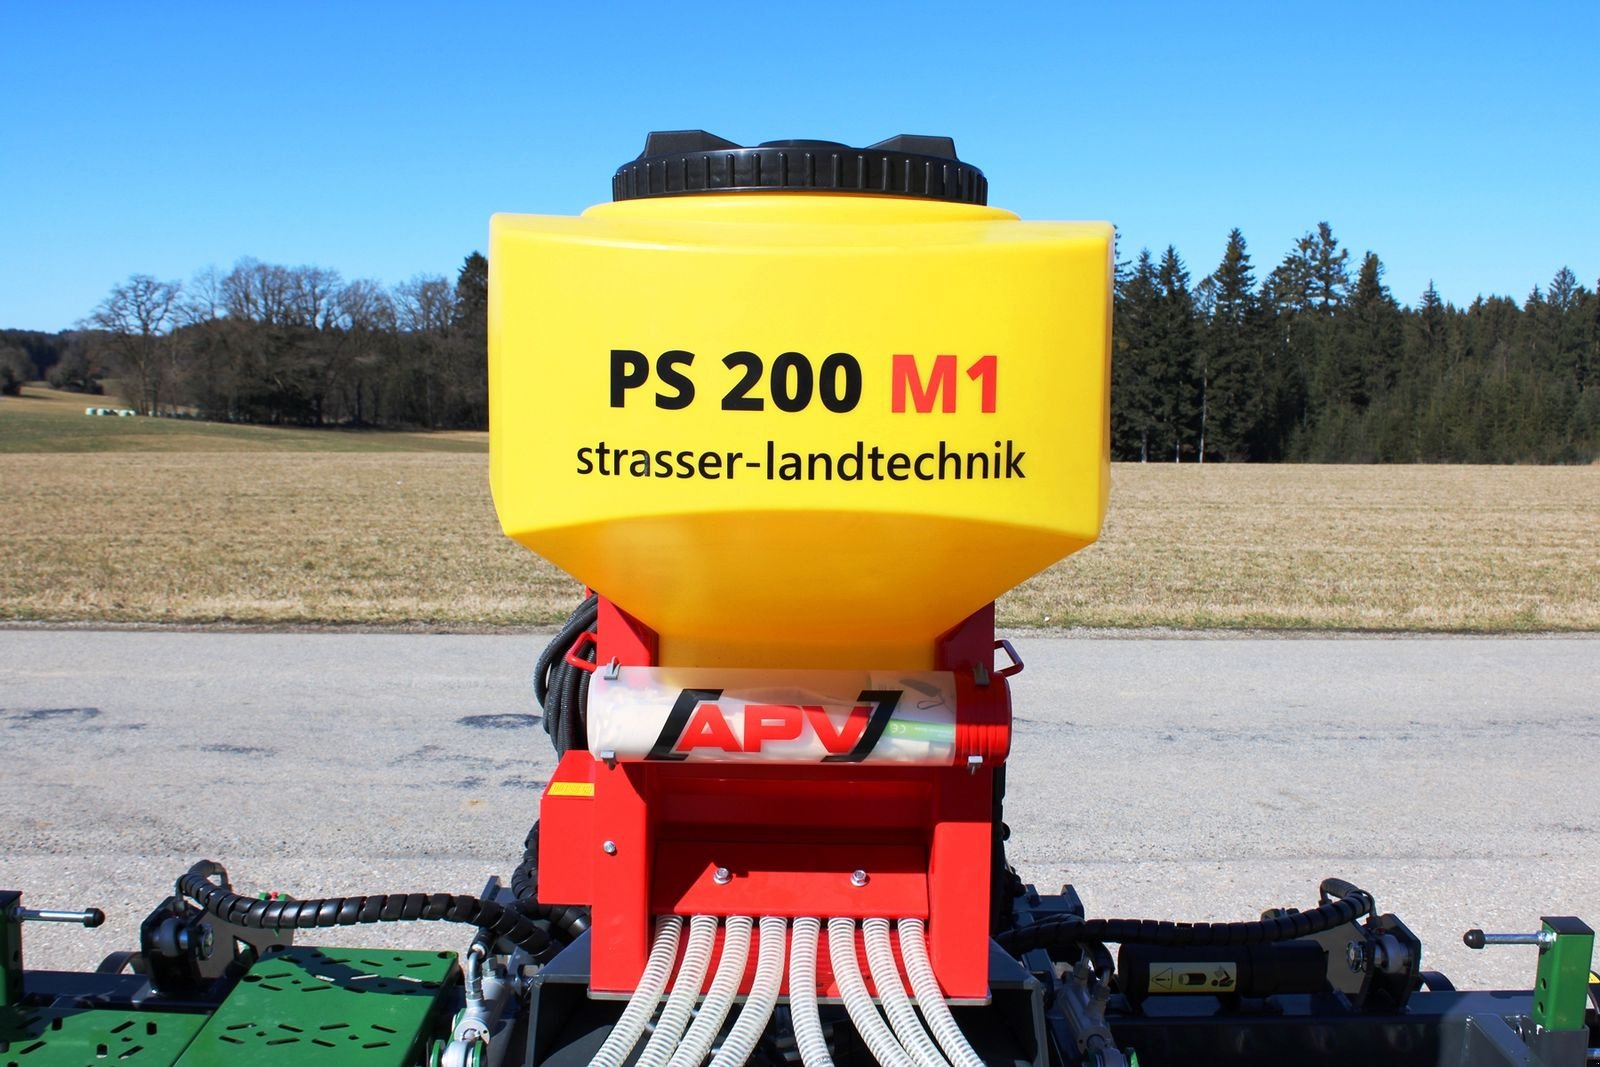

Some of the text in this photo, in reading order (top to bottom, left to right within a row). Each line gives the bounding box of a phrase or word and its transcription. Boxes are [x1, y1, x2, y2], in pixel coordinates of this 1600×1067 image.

[610, 350, 997, 413] PS 200 M1
[576, 440, 1026, 481] strasser-landtechnik
[675, 704, 874, 753] APV
